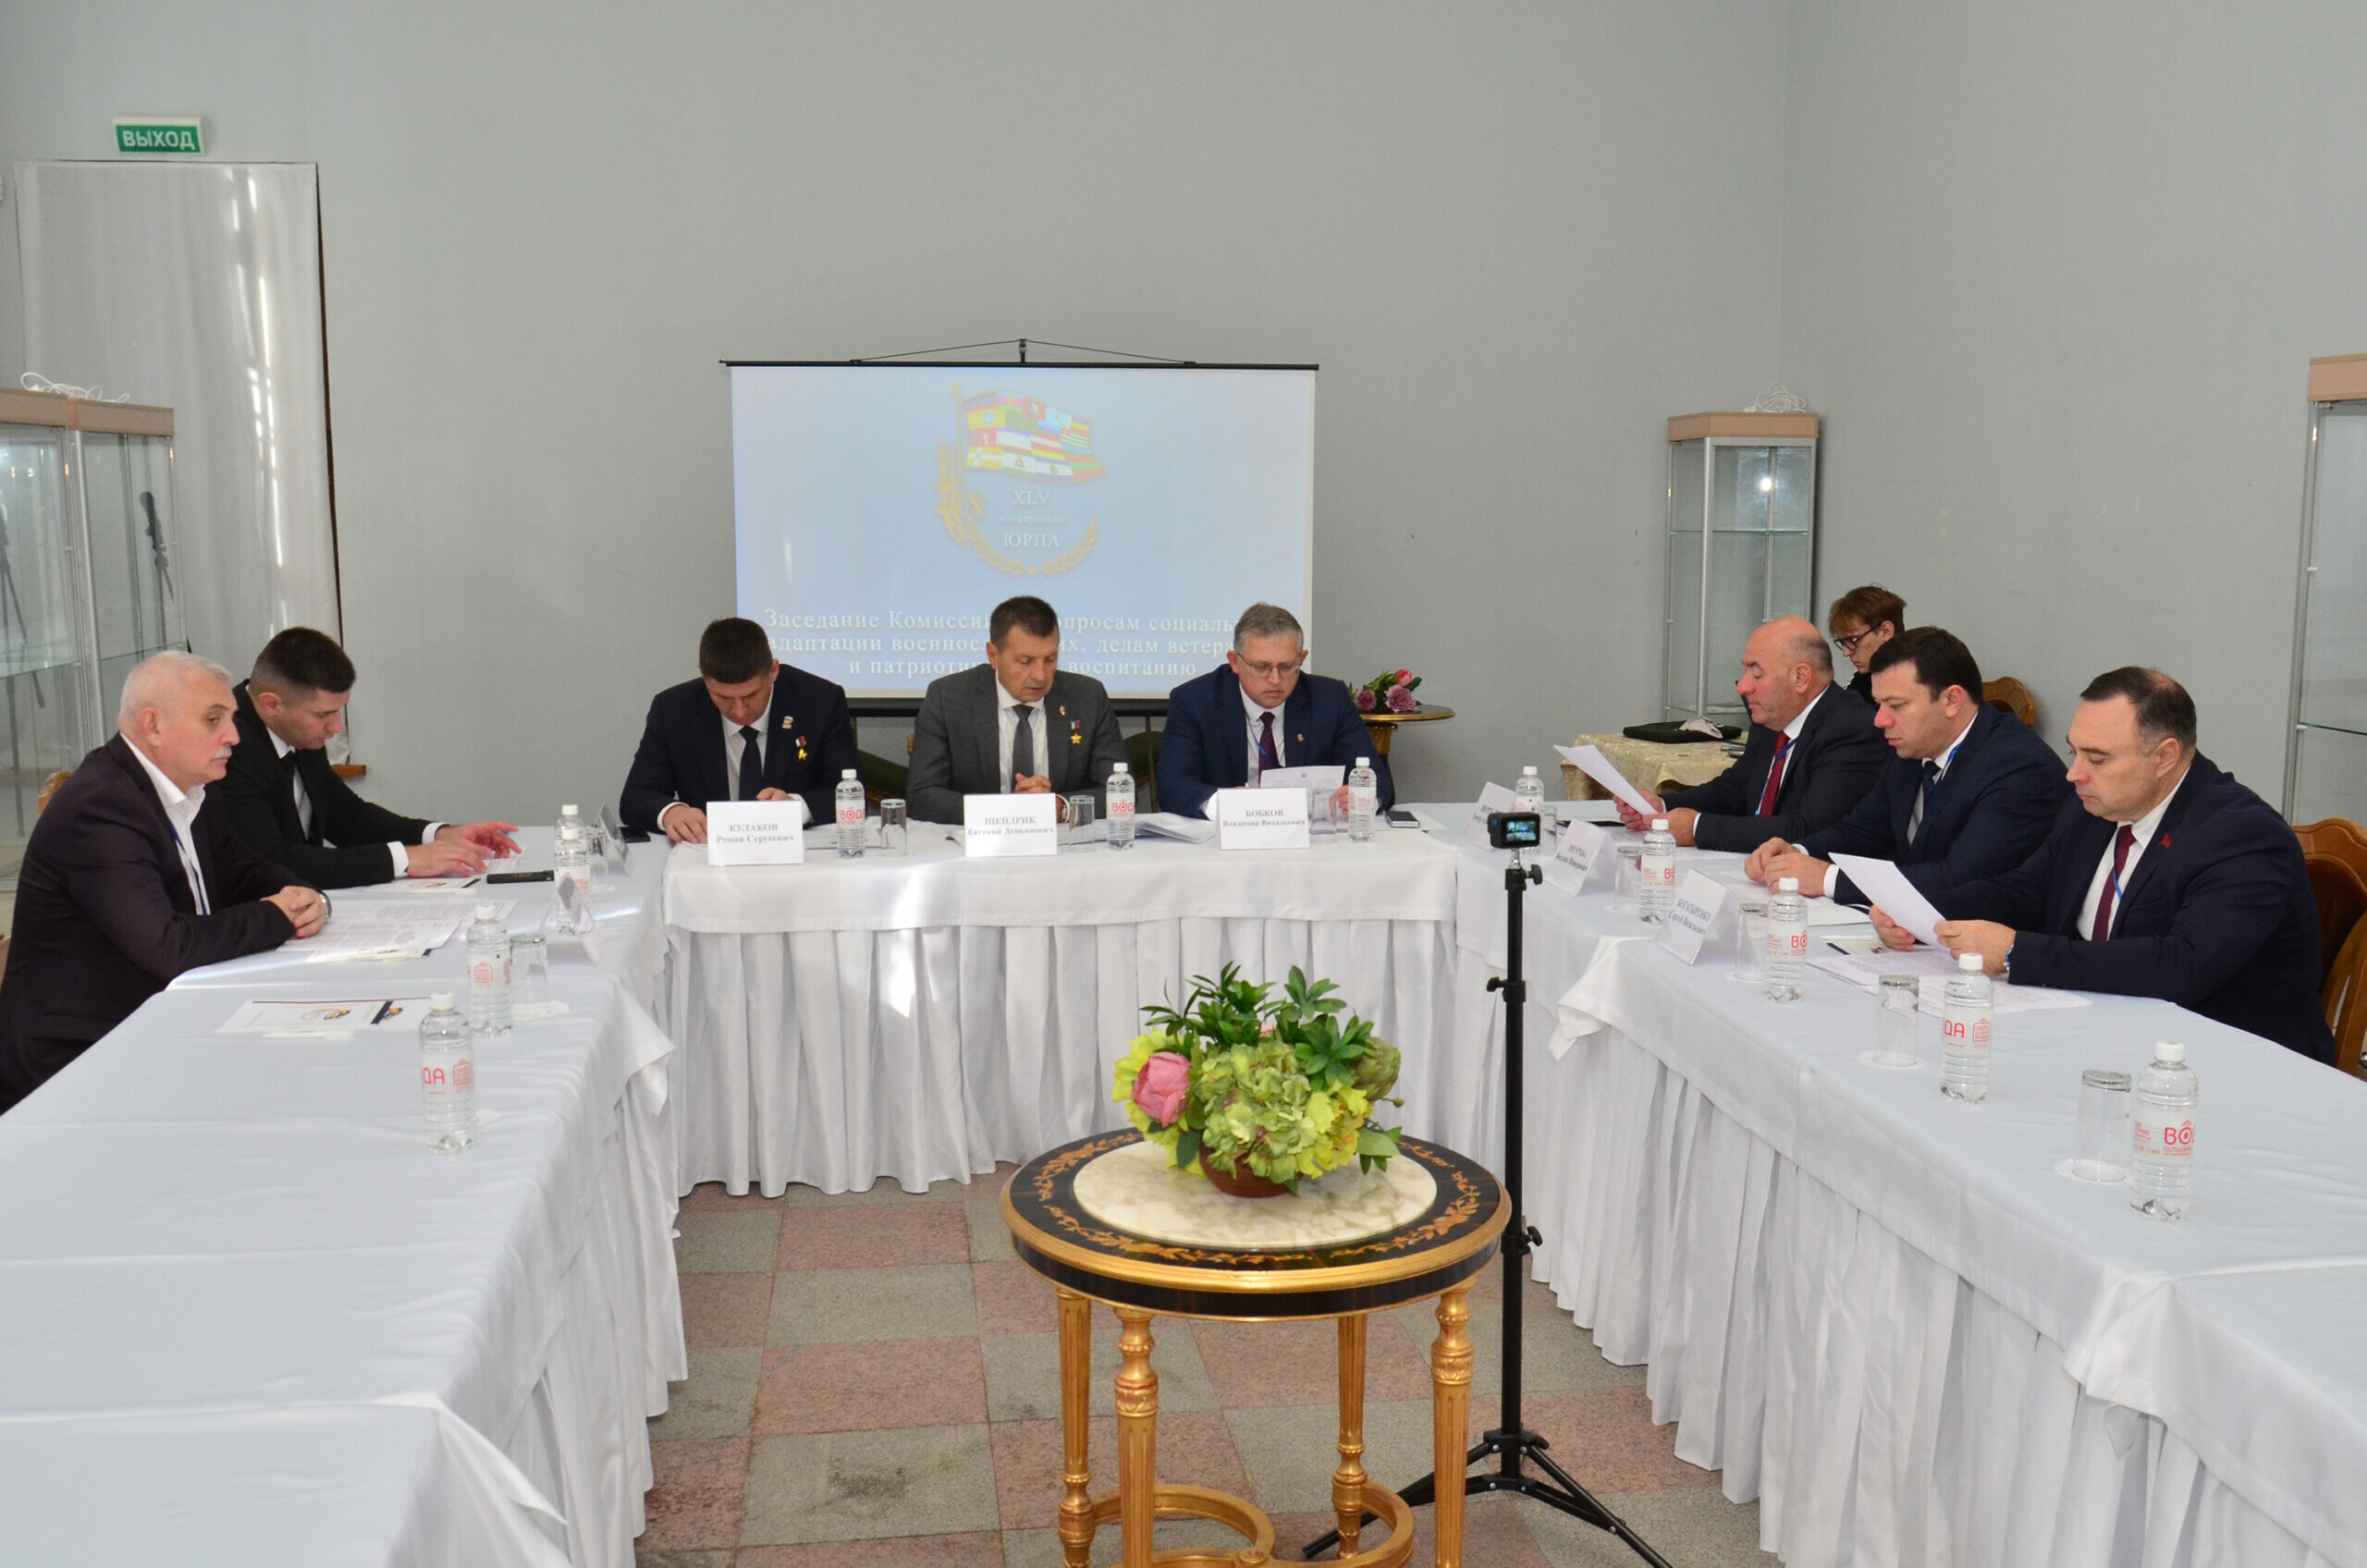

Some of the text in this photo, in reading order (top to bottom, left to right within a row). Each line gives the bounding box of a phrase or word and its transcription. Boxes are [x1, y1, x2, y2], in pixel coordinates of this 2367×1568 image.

[122, 130, 196, 150] ВЫХОД
[1013, 490, 1050, 506] XLV
[1002, 533, 1061, 548] ЮРПА
[764, 608, 879, 631] Заседание
[1148, 618, 1239, 632] социаль
[768, 635, 881, 653] адаптации
[1096, 639, 1158, 654] делам
[849, 660, 861, 674] и
[1068, 661, 1196, 677] воспитанию
[730, 823, 779, 832] КУЛАКОВ
